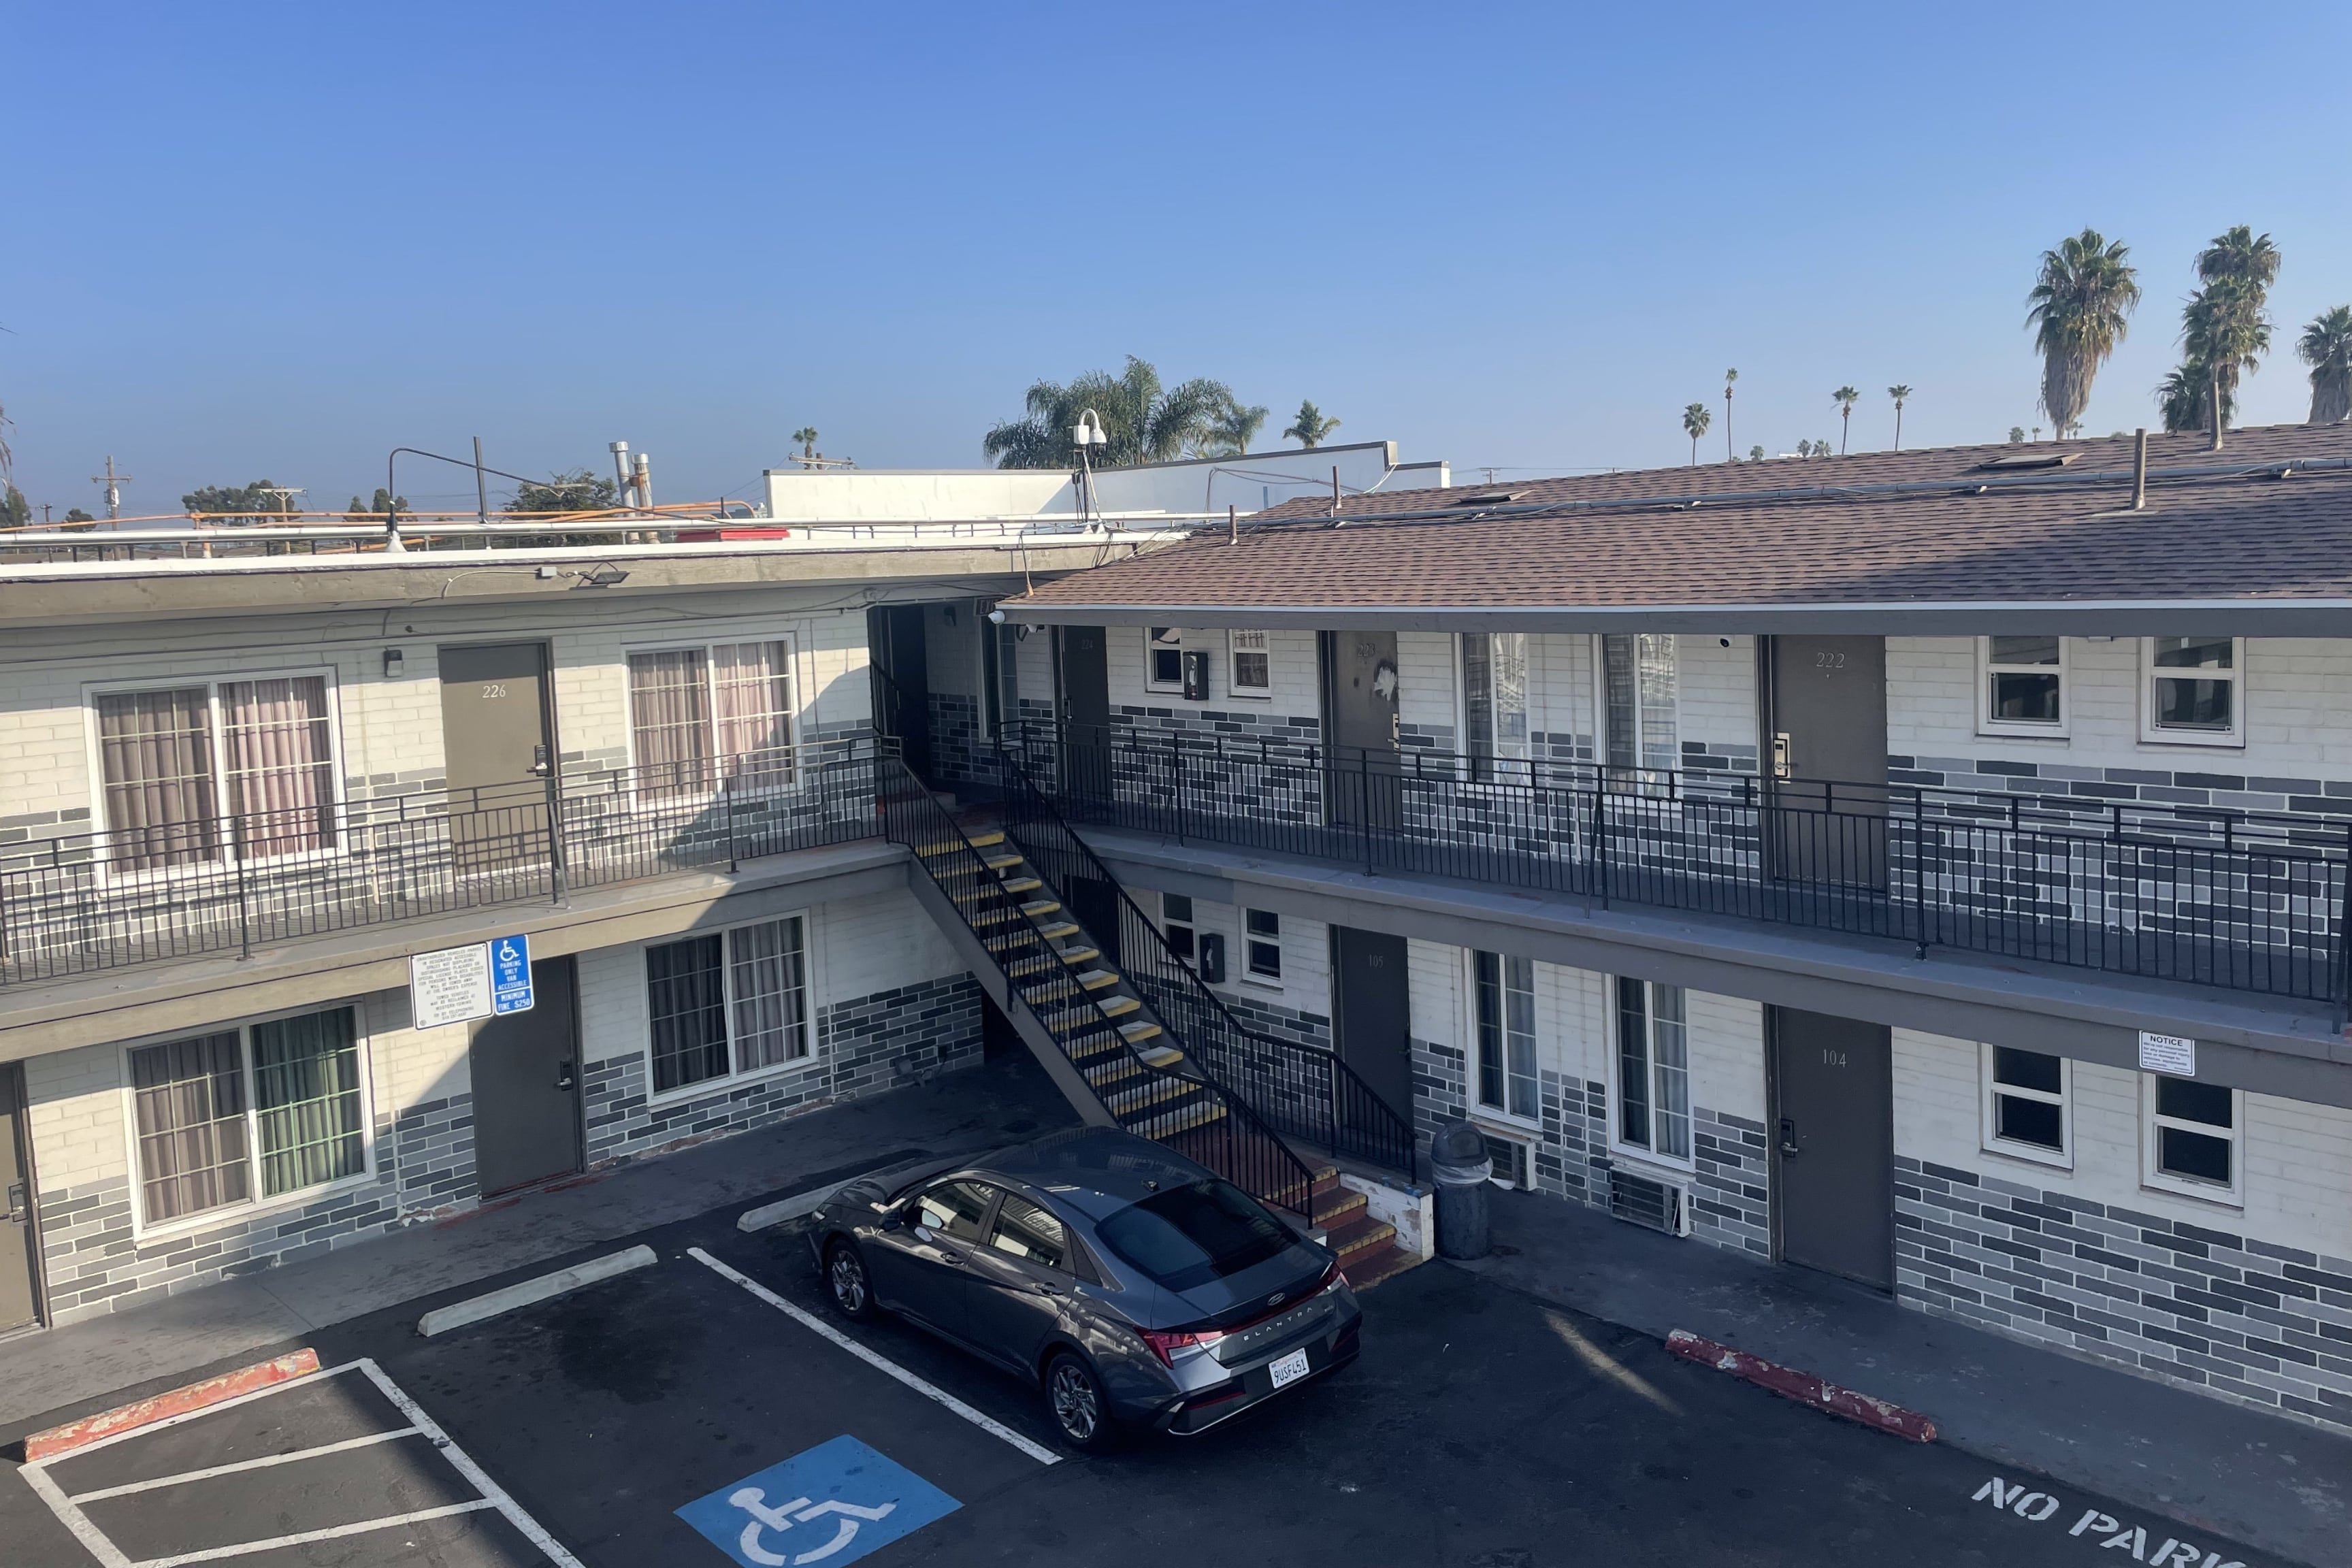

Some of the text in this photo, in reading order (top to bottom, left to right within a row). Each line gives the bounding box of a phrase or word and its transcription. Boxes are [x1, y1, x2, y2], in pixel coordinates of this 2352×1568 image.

[980, 600, 994, 613] EXI
[1358, 643, 1375, 657] 223
[1816, 652, 1845, 668] 222
[482, 684, 506, 698] 226
[500, 960, 521, 969] PARKING
[1369, 954, 1384, 968] 105
[504, 967, 517, 975] ONLY
[498, 980, 527, 991] ACCESSIBLE
[501, 991, 525, 1002] MINIMUM
[498, 998, 530, 1011] FINE $250
[2151, 1035, 2183, 1047] NOTICE
[1823, 1049, 1846, 1067] 104
[1243, 1307, 1312, 1341] ELANTRA
[1274, 1359, 1307, 1384] 9USF451
[1971, 1477, 2059, 1520] NO
